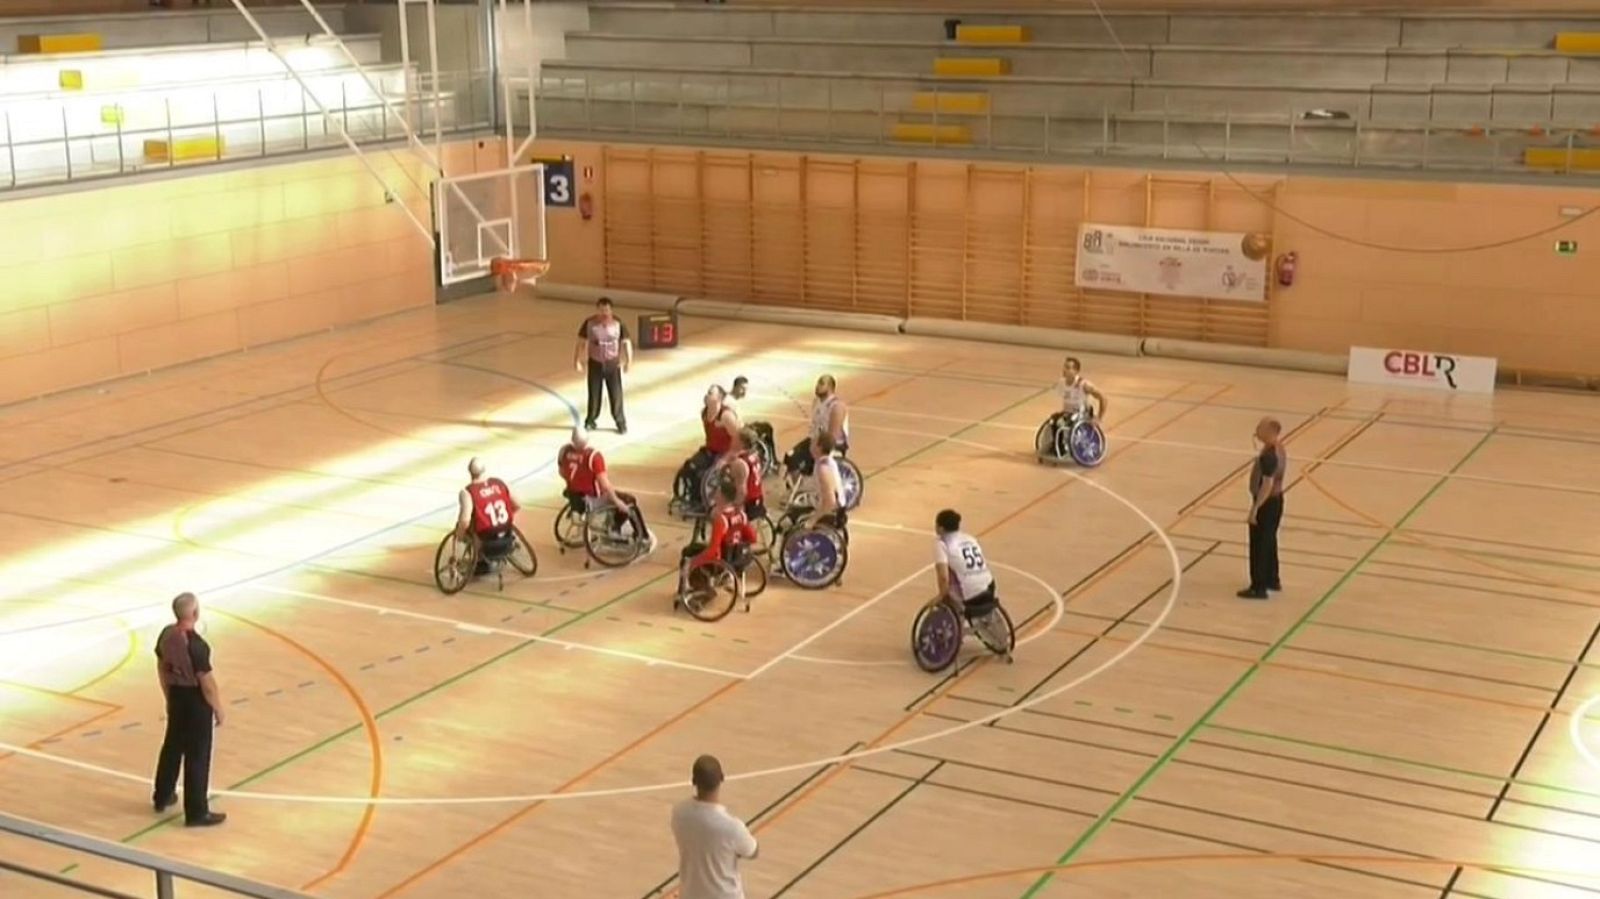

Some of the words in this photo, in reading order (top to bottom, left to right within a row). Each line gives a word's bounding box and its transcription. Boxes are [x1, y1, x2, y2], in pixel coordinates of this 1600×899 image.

[550, 174, 569, 203] 3
[653, 323, 673, 343] 13
[569, 462, 578, 480] 7
[485, 499, 508, 527] 13
[962, 546, 984, 569] 55
